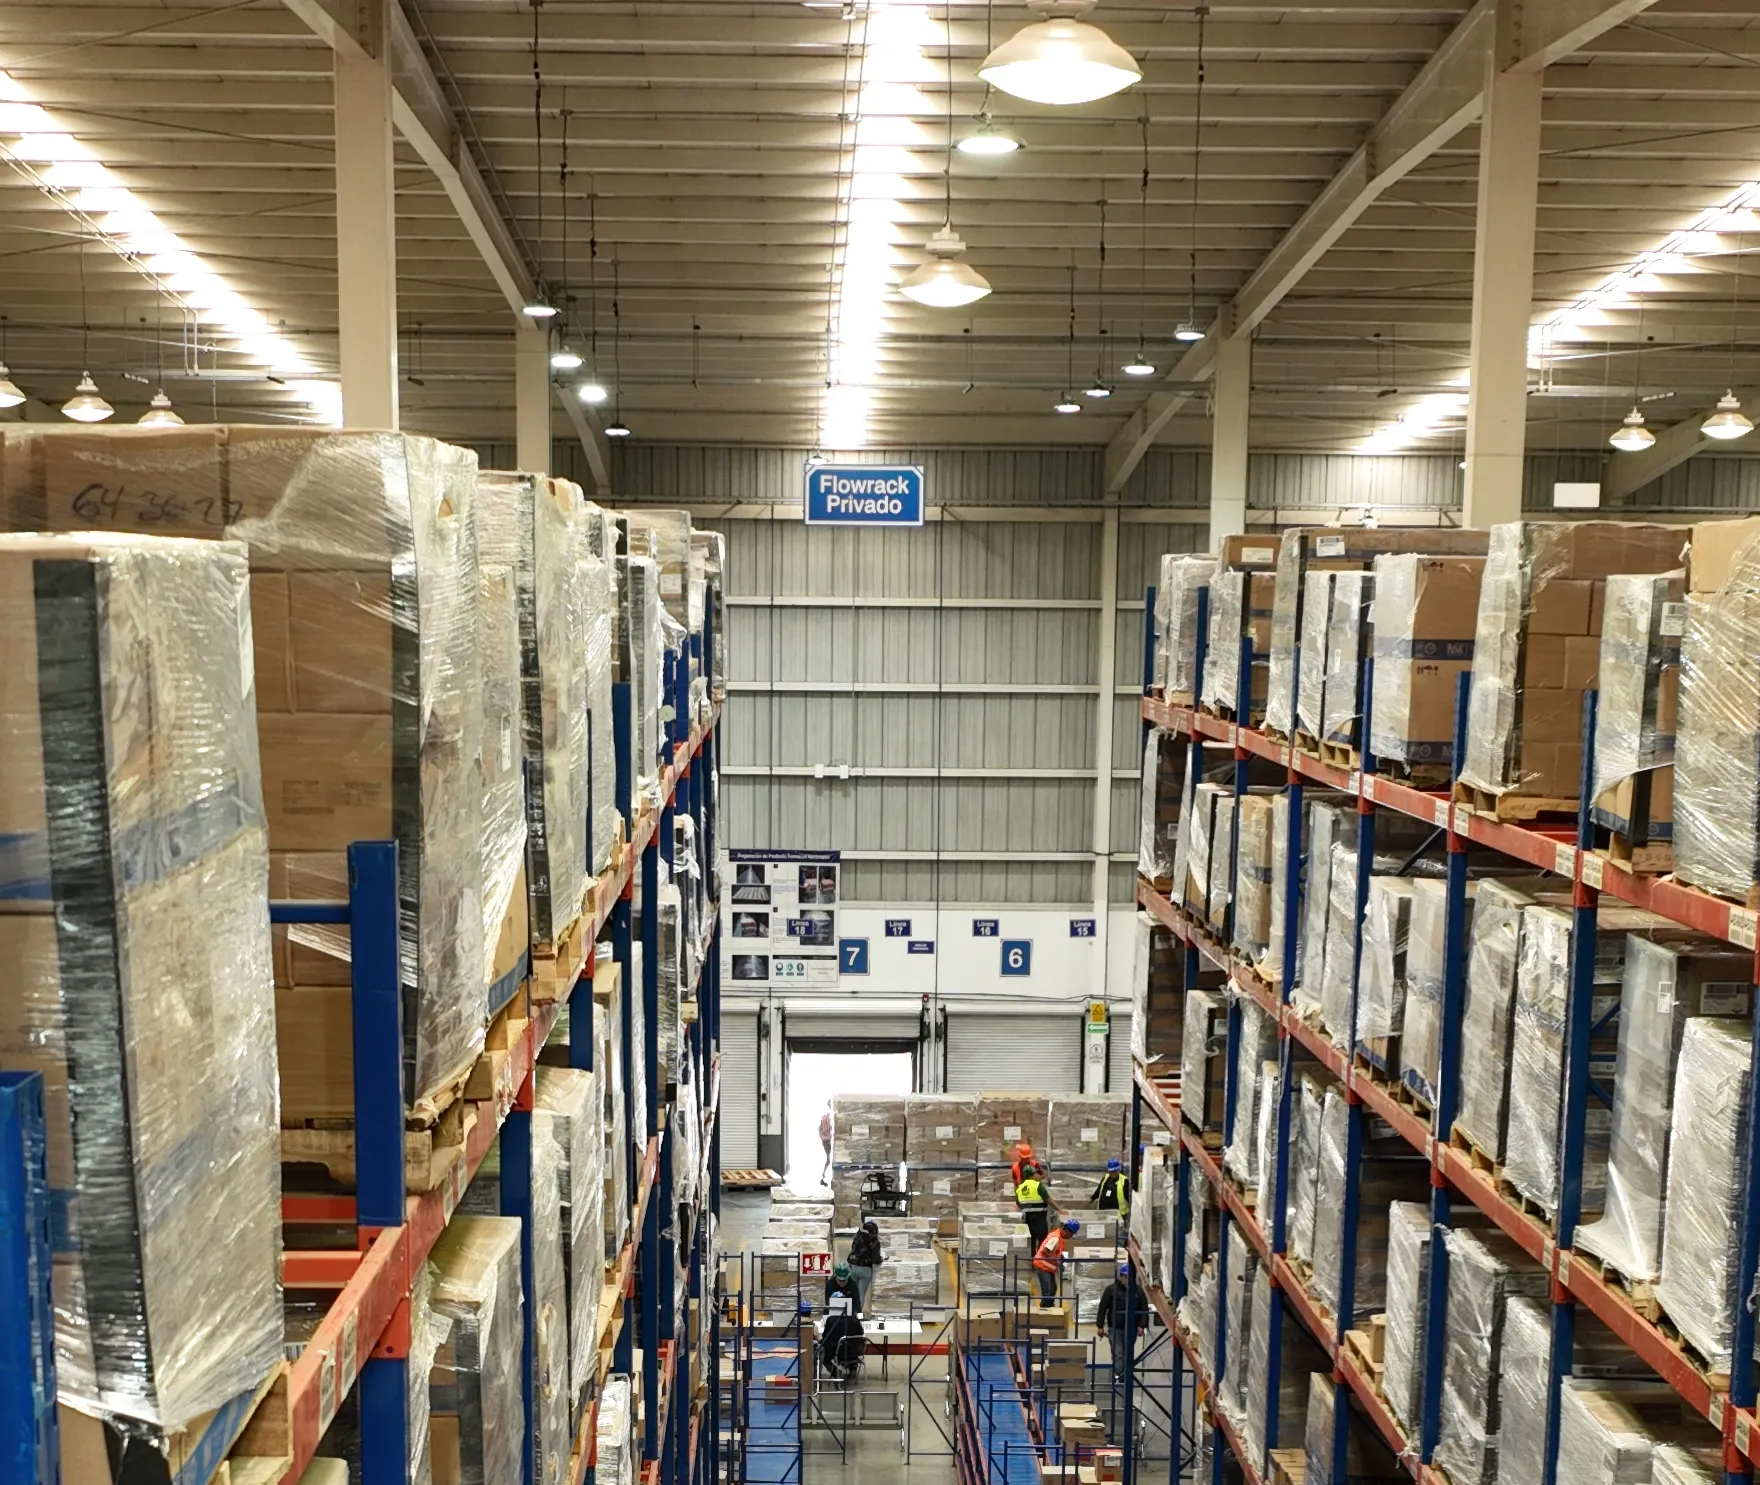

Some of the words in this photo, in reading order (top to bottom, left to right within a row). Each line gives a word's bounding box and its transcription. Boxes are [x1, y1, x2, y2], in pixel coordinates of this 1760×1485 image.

[819, 474, 910, 495] Flowrack
[826, 494, 903, 515] Privado
[794, 926, 806, 936] 18
[892, 927, 903, 935] 17
[980, 927, 991, 935] 16
[1077, 927, 1089, 936] 15
[846, 947, 860, 966] 7
[1008, 948, 1023, 968] 6
